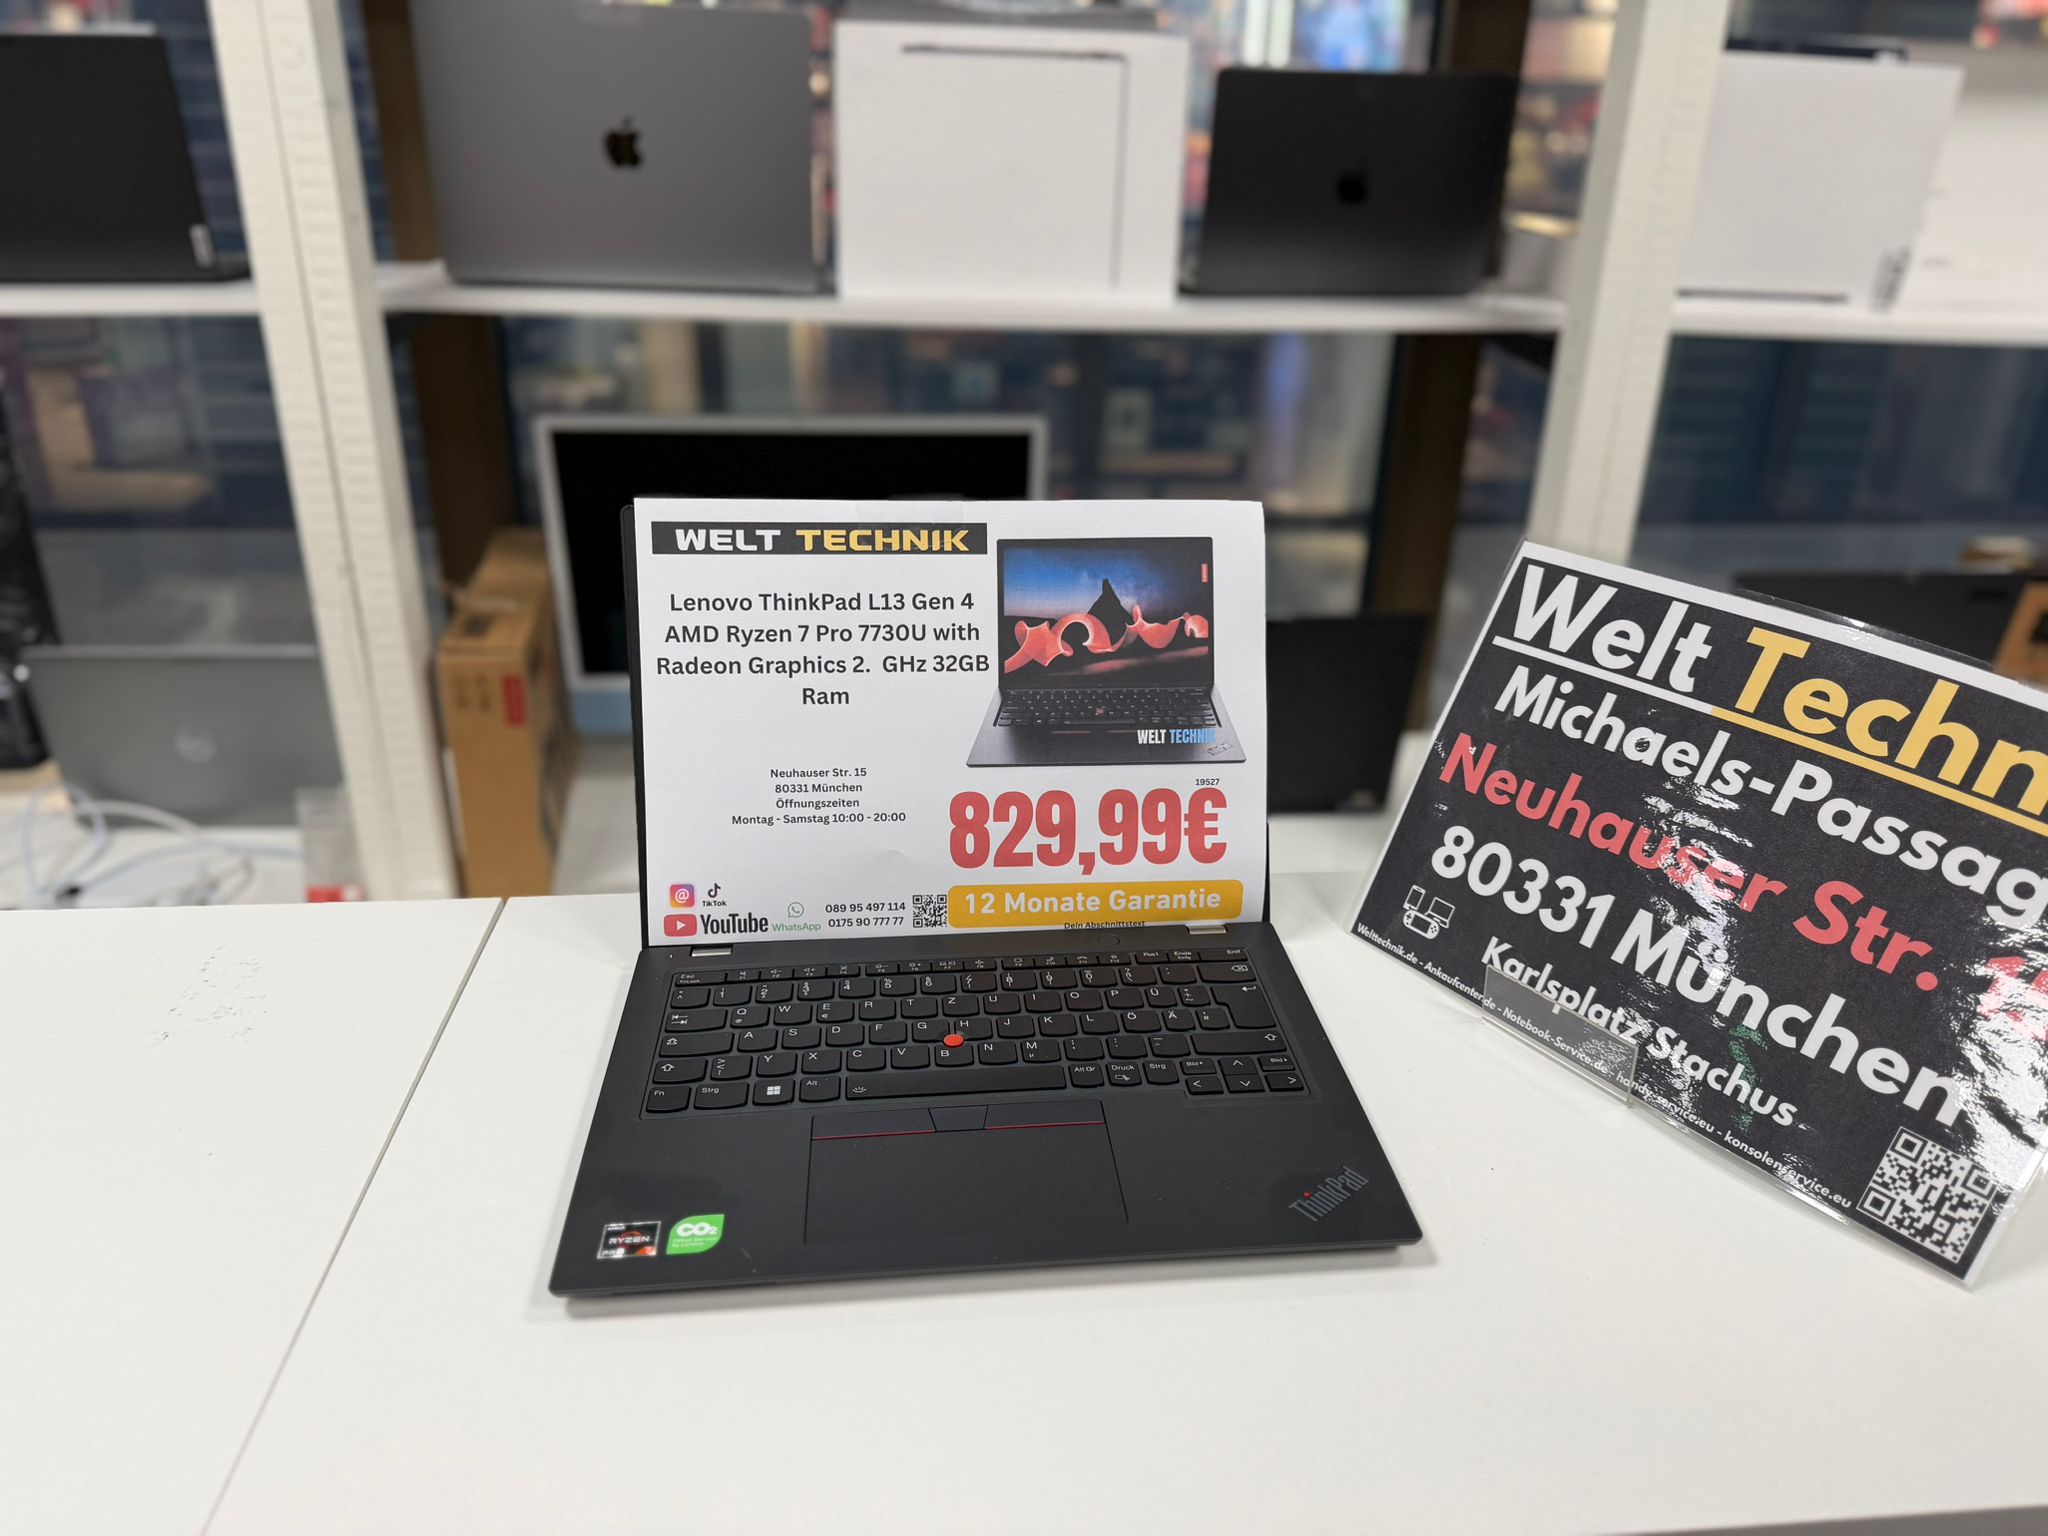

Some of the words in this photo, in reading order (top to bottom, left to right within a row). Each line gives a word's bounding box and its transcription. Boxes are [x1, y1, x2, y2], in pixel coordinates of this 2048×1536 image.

[676, 528, 780, 551] WELT
[796, 529, 969, 552] TECHNIK
[670, 593, 752, 611] Lenovo
[759, 592, 861, 610] ThinkPad
[869, 592, 905, 610] L13
[912, 592, 954, 610] Gen
[960, 592, 974, 609] 4
[664, 626, 718, 642] AMD
[726, 624, 792, 647] Ryzen
[798, 625, 809, 641] 7
[816, 625, 852, 642] Pro
[858, 624, 926, 641] 7730U
[934, 623, 980, 640] with
[657, 657, 742, 675] Radeon
[748, 655, 846, 678] Graphics
[852, 656, 871, 673] 2.
[882, 656, 926, 672] GHz
[933, 655, 990, 672] 32GB
[802, 688, 850, 704] Ram
[1513, 564, 1712, 692] Welt
[1735, 627, 2048, 816] Techn
[1138, 729, 1166, 744] WELT
[770, 768, 830, 778] Neuhauser
[832, 768, 852, 777] Str.
[854, 768, 867, 777] 15
[1196, 778, 1220, 786] 19527
[775, 784, 808, 793] 80331
[812, 782, 862, 792] München
[1494, 664, 2048, 928] Michaels-Passag
[776, 797, 860, 810] Öffnungszeiten
[732, 815, 774, 826] Montag
[783, 814, 830, 826] Samstag
[832, 812, 864, 823] 10:00
[874, 812, 906, 822] 20:00
[949, 788, 1226, 876] 829,99€
[1439, 732, 1787, 912] Neuhauser
[1793, 880, 1938, 991] Str.
[826, 904, 846, 913] 089
[850, 903, 864, 912] 95
[866, 902, 885, 912] 497
[888, 902, 906, 911] 114
[965, 893, 995, 914] 12
[1005, 892, 1100, 913] Monate
[1110, 888, 1220, 911] Garantie
[700, 912, 768, 935] YouTube
[772, 922, 821, 933] WhatsApp
[828, 918, 854, 928] 0175
[856, 918, 870, 927] 90
[872, 917, 890, 927] 777
[892, 916, 904, 926] 77
[1085, 920, 1145, 928] Abschnittstext
[1432, 825, 1615, 949] 80331
[1610, 908, 1966, 1127] München
[1481, 936, 1641, 1045] Karlsplatz
[1647, 1026, 1798, 1126] Stachus
[1357, 922, 1418, 965] Welttechnik.de
[1424, 961, 1496, 1010] Ankaufcenter.de
[1503, 1006, 1609, 1074] Notebook-Service.de
[1724, 1130, 1852, 1208] konsolenservice.eu
[1288, 1166, 1369, 1222] ThinkPad
[609, 1236, 650, 1245] RYZEN
